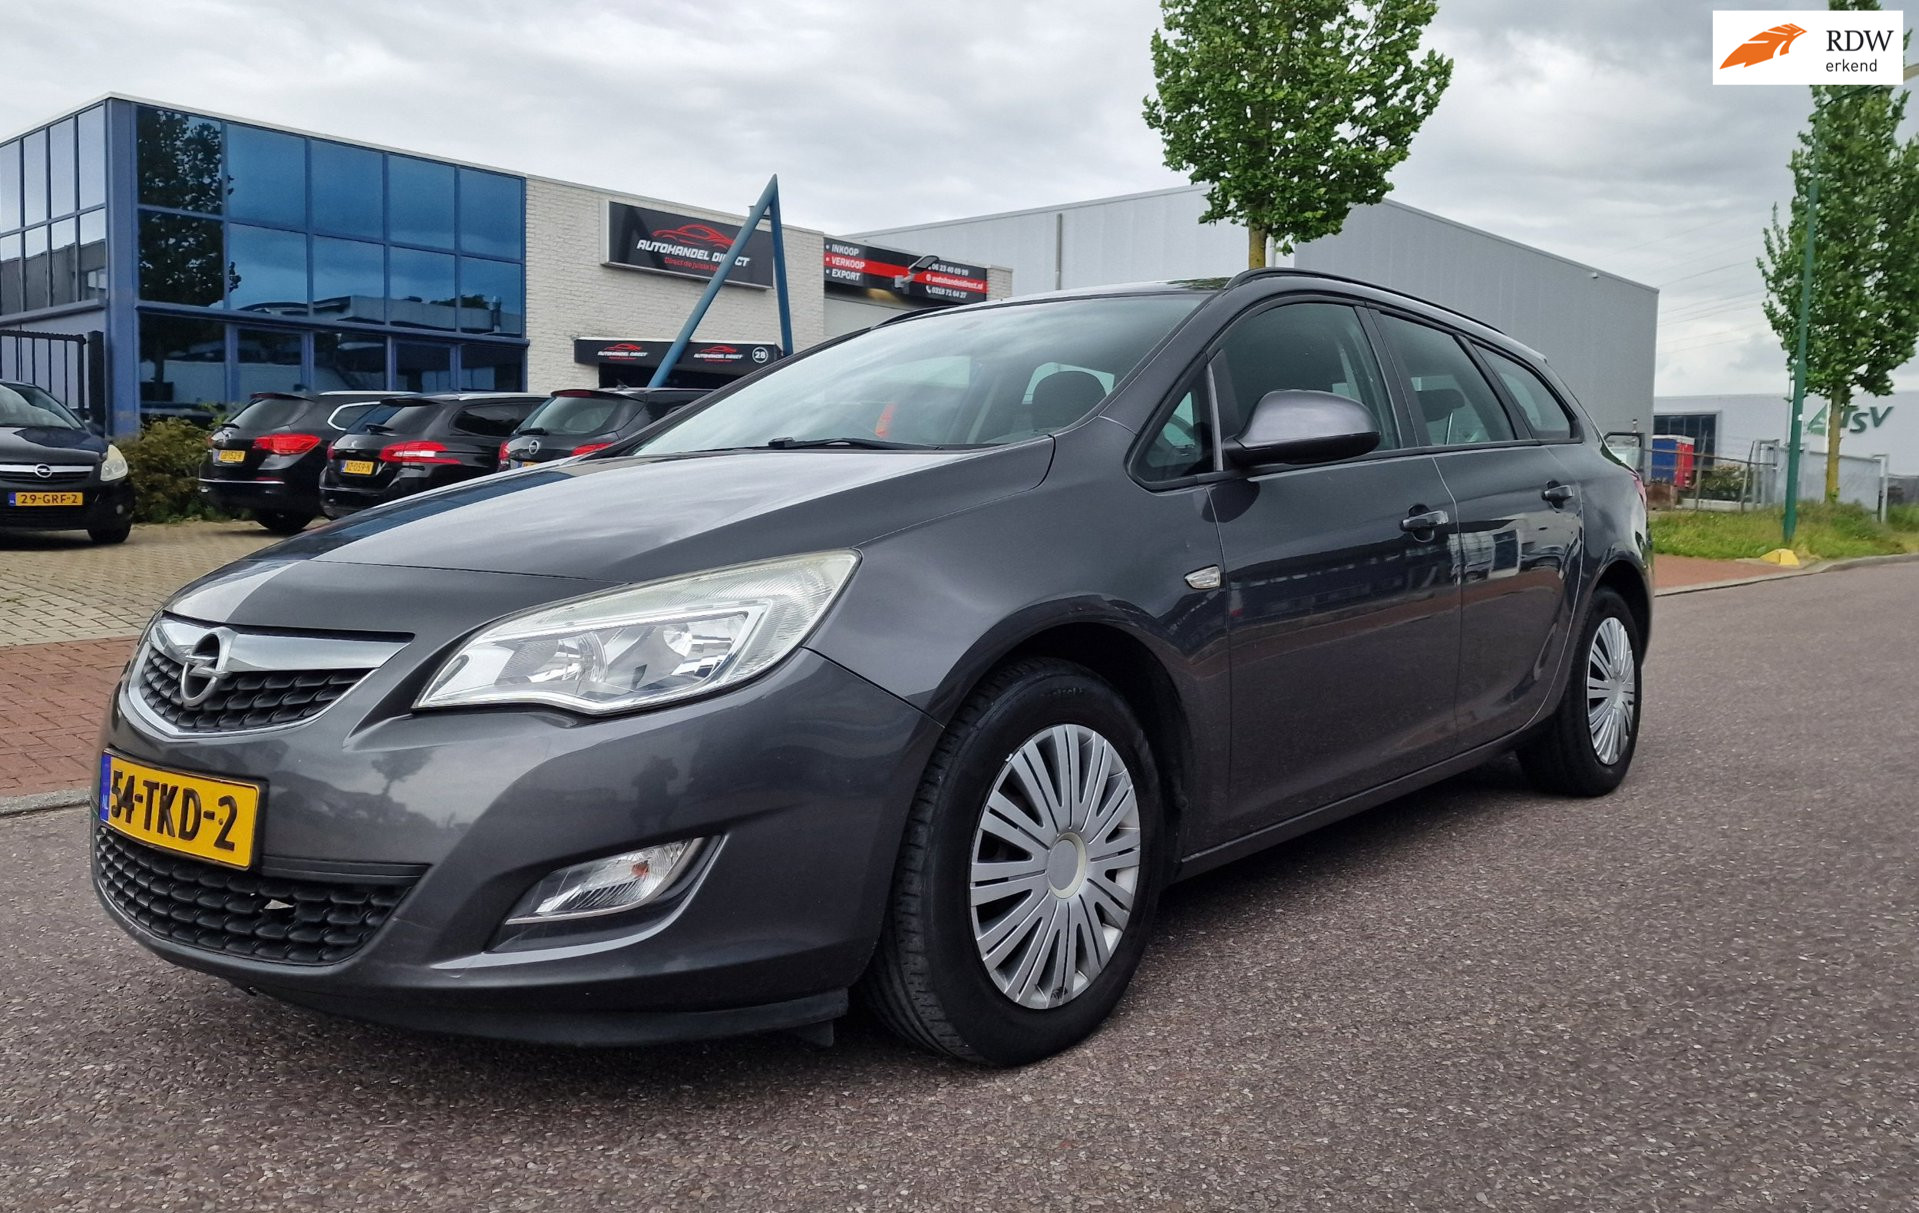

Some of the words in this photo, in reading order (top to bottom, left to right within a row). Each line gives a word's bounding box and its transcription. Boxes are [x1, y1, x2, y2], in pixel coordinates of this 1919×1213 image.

[636, 239, 710, 261] AUTOHANDEL
[711, 253, 751, 267] DICT
[831, 244, 860, 256] INKOOP
[831, 256, 866, 270] VERKOOP
[831, 269, 861, 281] EXPORT
[754, 351, 766, 359] 28
[20, 494, 78, 504] 29-GRF-2
[110, 770, 238, 852] 54-TKD-2
